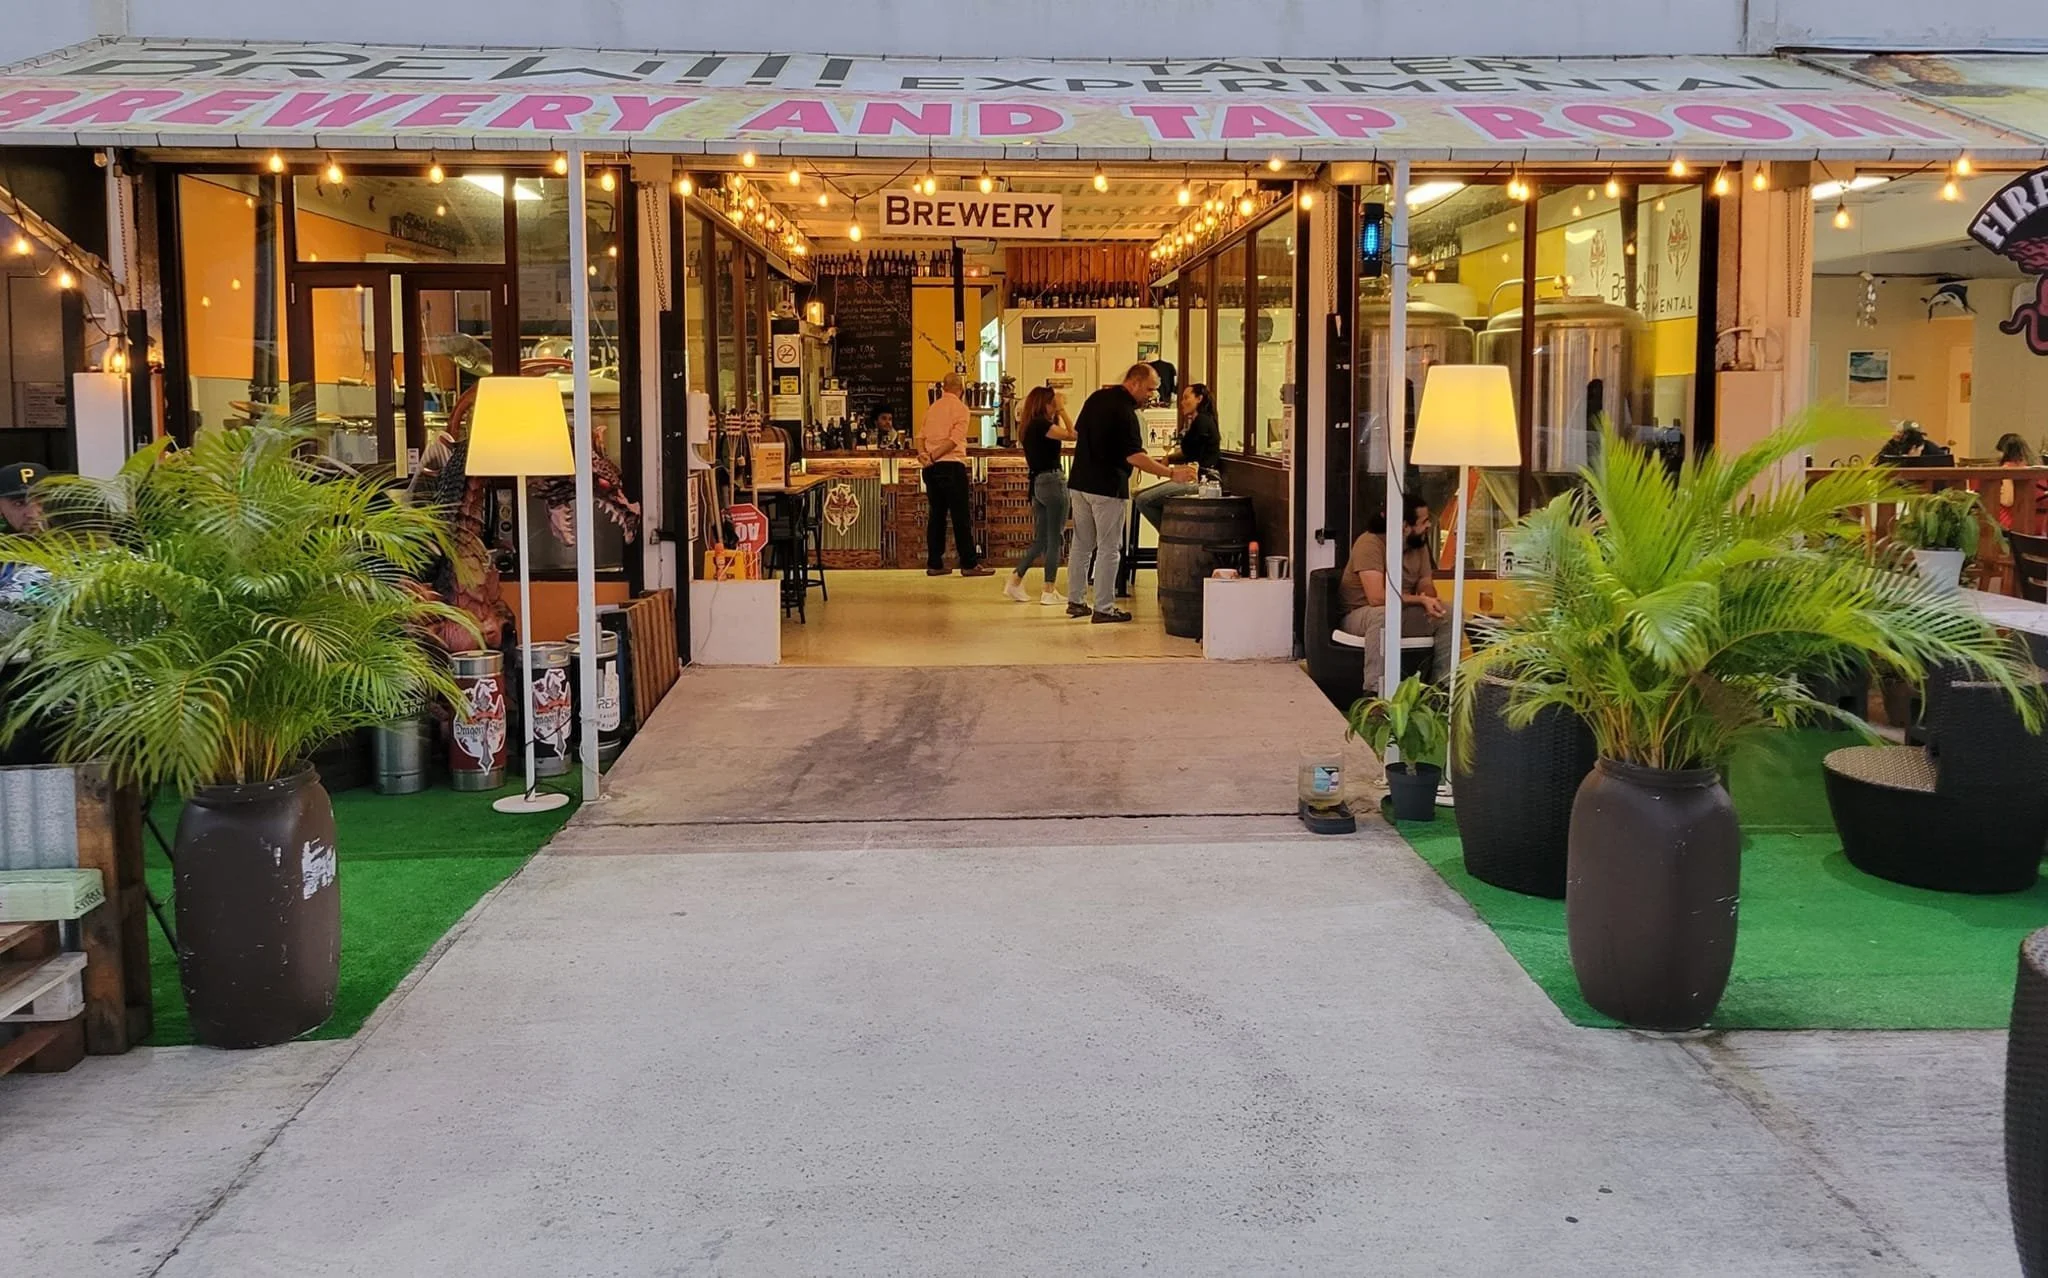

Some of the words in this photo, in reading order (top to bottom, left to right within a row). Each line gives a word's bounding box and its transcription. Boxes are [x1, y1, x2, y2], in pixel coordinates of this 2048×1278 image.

[1126, 57, 1546, 76] TALLER
[901, 74, 1833, 93] EXPERIMENTAL
[0, 89, 699, 131] BREWERY
[738, 99, 1065, 136] AND
[1129, 105, 1397, 139] TAP
[1456, 103, 1954, 141] ROOM
[20, 468, 35, 484] P
